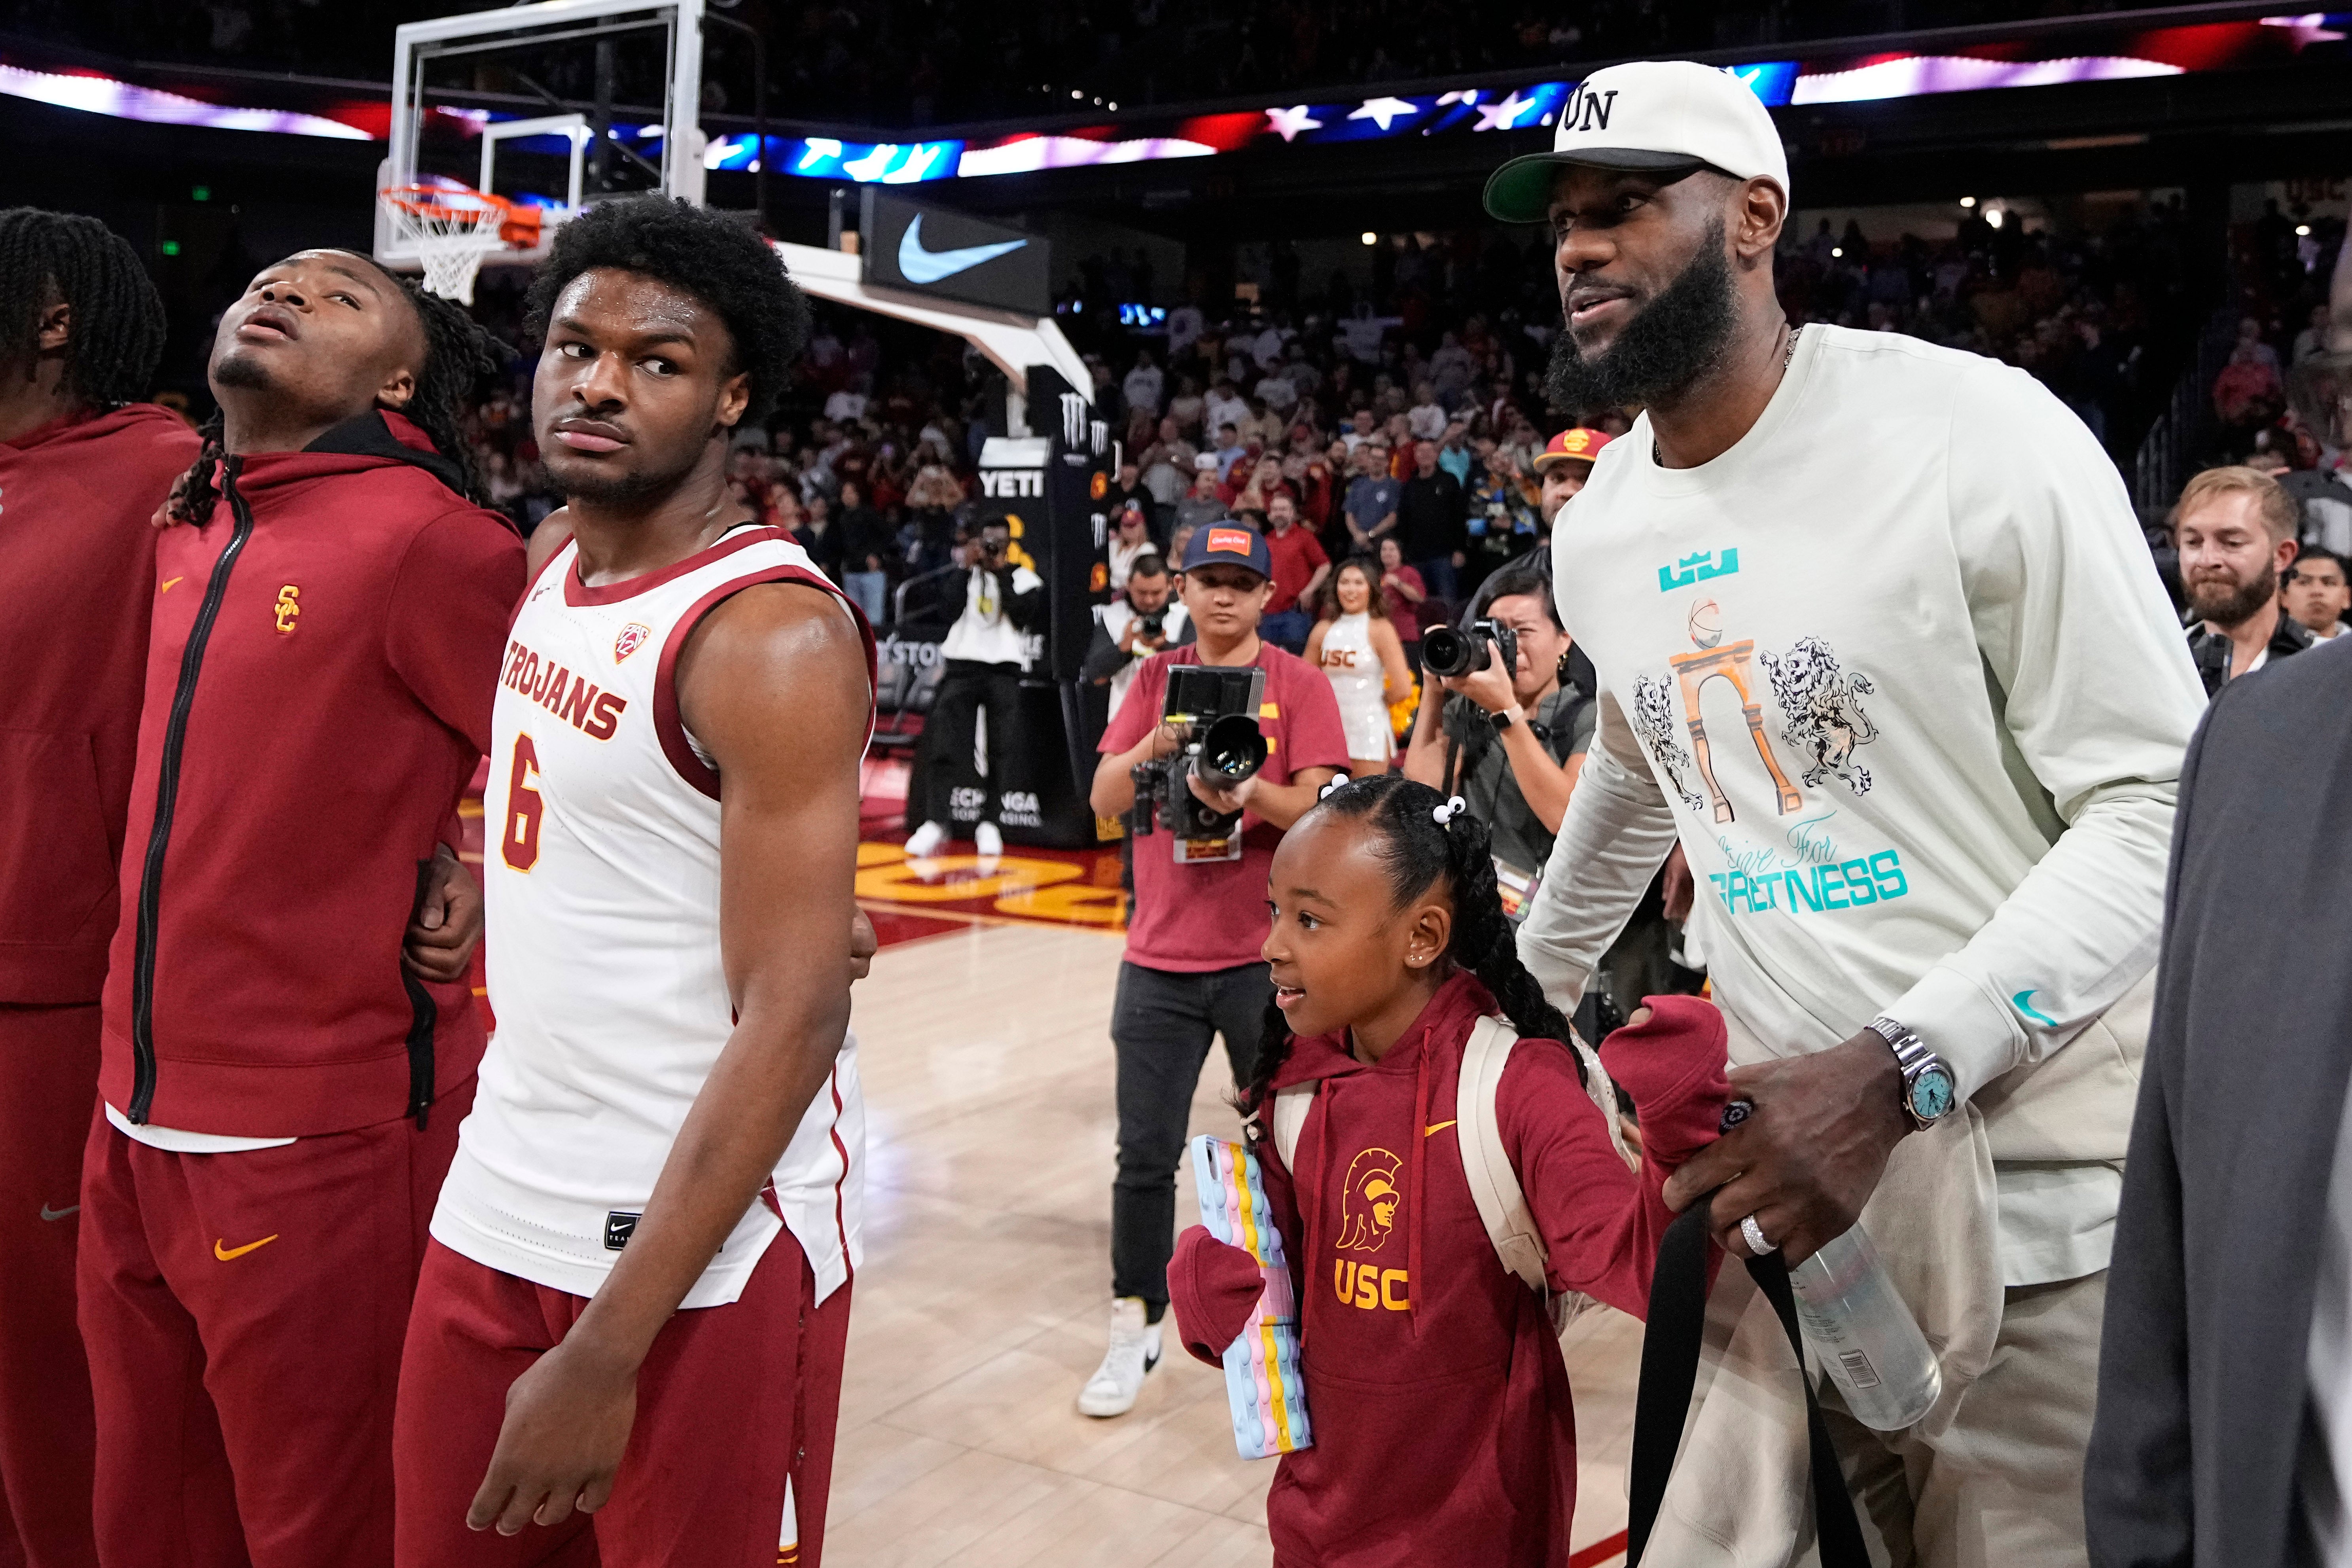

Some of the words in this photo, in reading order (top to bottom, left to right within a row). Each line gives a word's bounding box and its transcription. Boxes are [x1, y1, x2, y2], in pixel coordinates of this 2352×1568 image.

[1564, 81, 1618, 131] UN
[979, 470, 1044, 498] YETI
[616, 639, 634, 655] 12
[617, 624, 650, 650] PAC
[500, 640, 628, 741] TROJANS
[500, 731, 545, 875] 6
[1780, 810, 1838, 868] For
[1709, 849, 1908, 915] GRETNESS
[1334, 1258, 1410, 1310] USC
